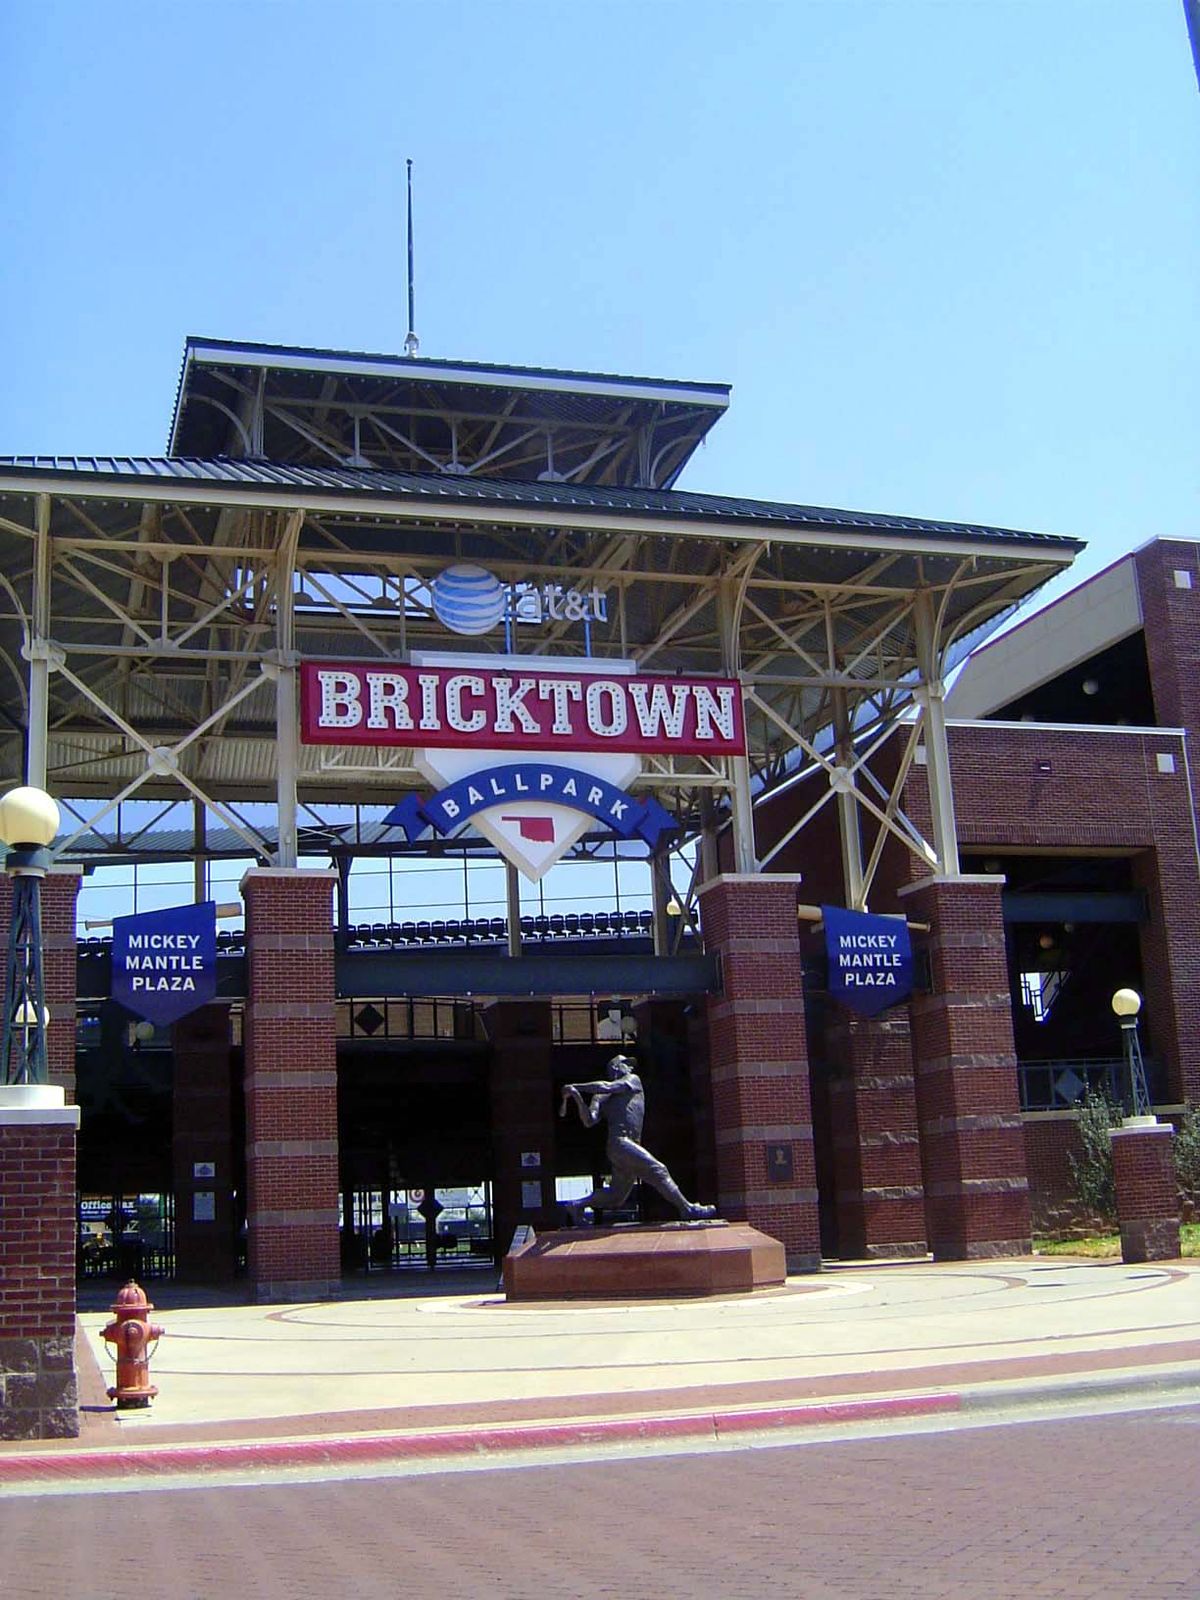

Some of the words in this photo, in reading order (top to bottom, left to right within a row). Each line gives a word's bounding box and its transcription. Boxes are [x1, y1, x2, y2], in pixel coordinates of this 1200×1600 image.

[518, 583, 608, 623] at&t
[317, 670, 736, 741] BRICKTOWN
[441, 773, 629, 821] BALLPARK
[128, 934, 201, 949] MICKEY
[839, 934, 897, 948] MICKEY
[125, 955, 204, 970] MANTLE
[839, 953, 902, 967] MANTLE
[132, 976, 196, 991] PLAZA
[845, 972, 896, 986] PLAZA
